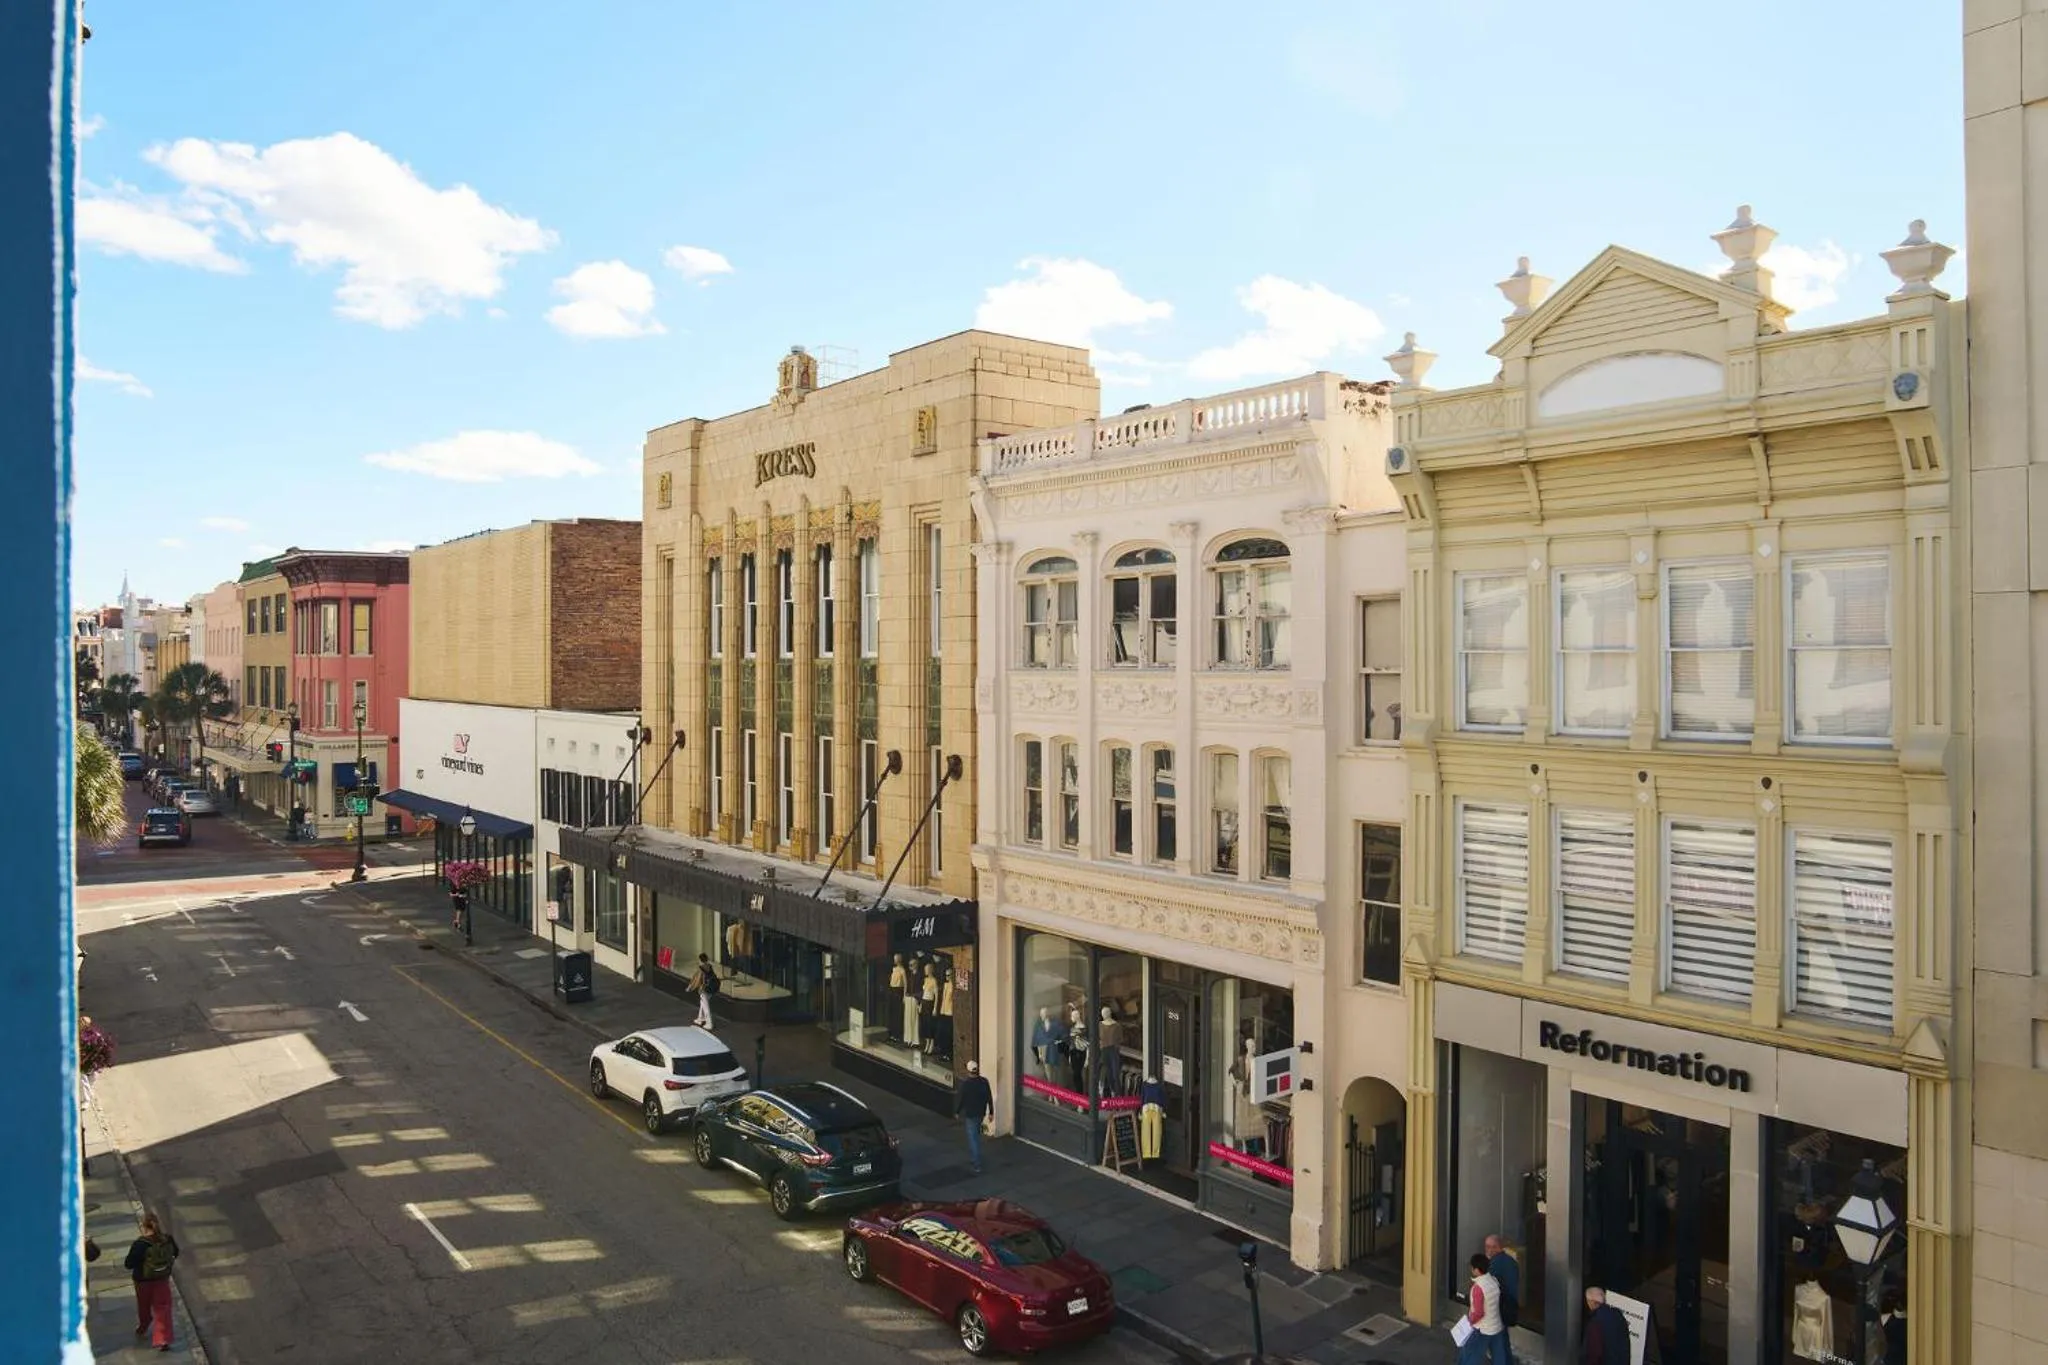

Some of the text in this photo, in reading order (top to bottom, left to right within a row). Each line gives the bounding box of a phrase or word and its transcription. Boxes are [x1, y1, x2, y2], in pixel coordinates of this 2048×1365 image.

[755, 441, 816, 488] KRESS
[441, 753, 484, 776] vineyard vines
[911, 916, 935, 938] H&M
[1539, 1020, 1752, 1093] Reformation
